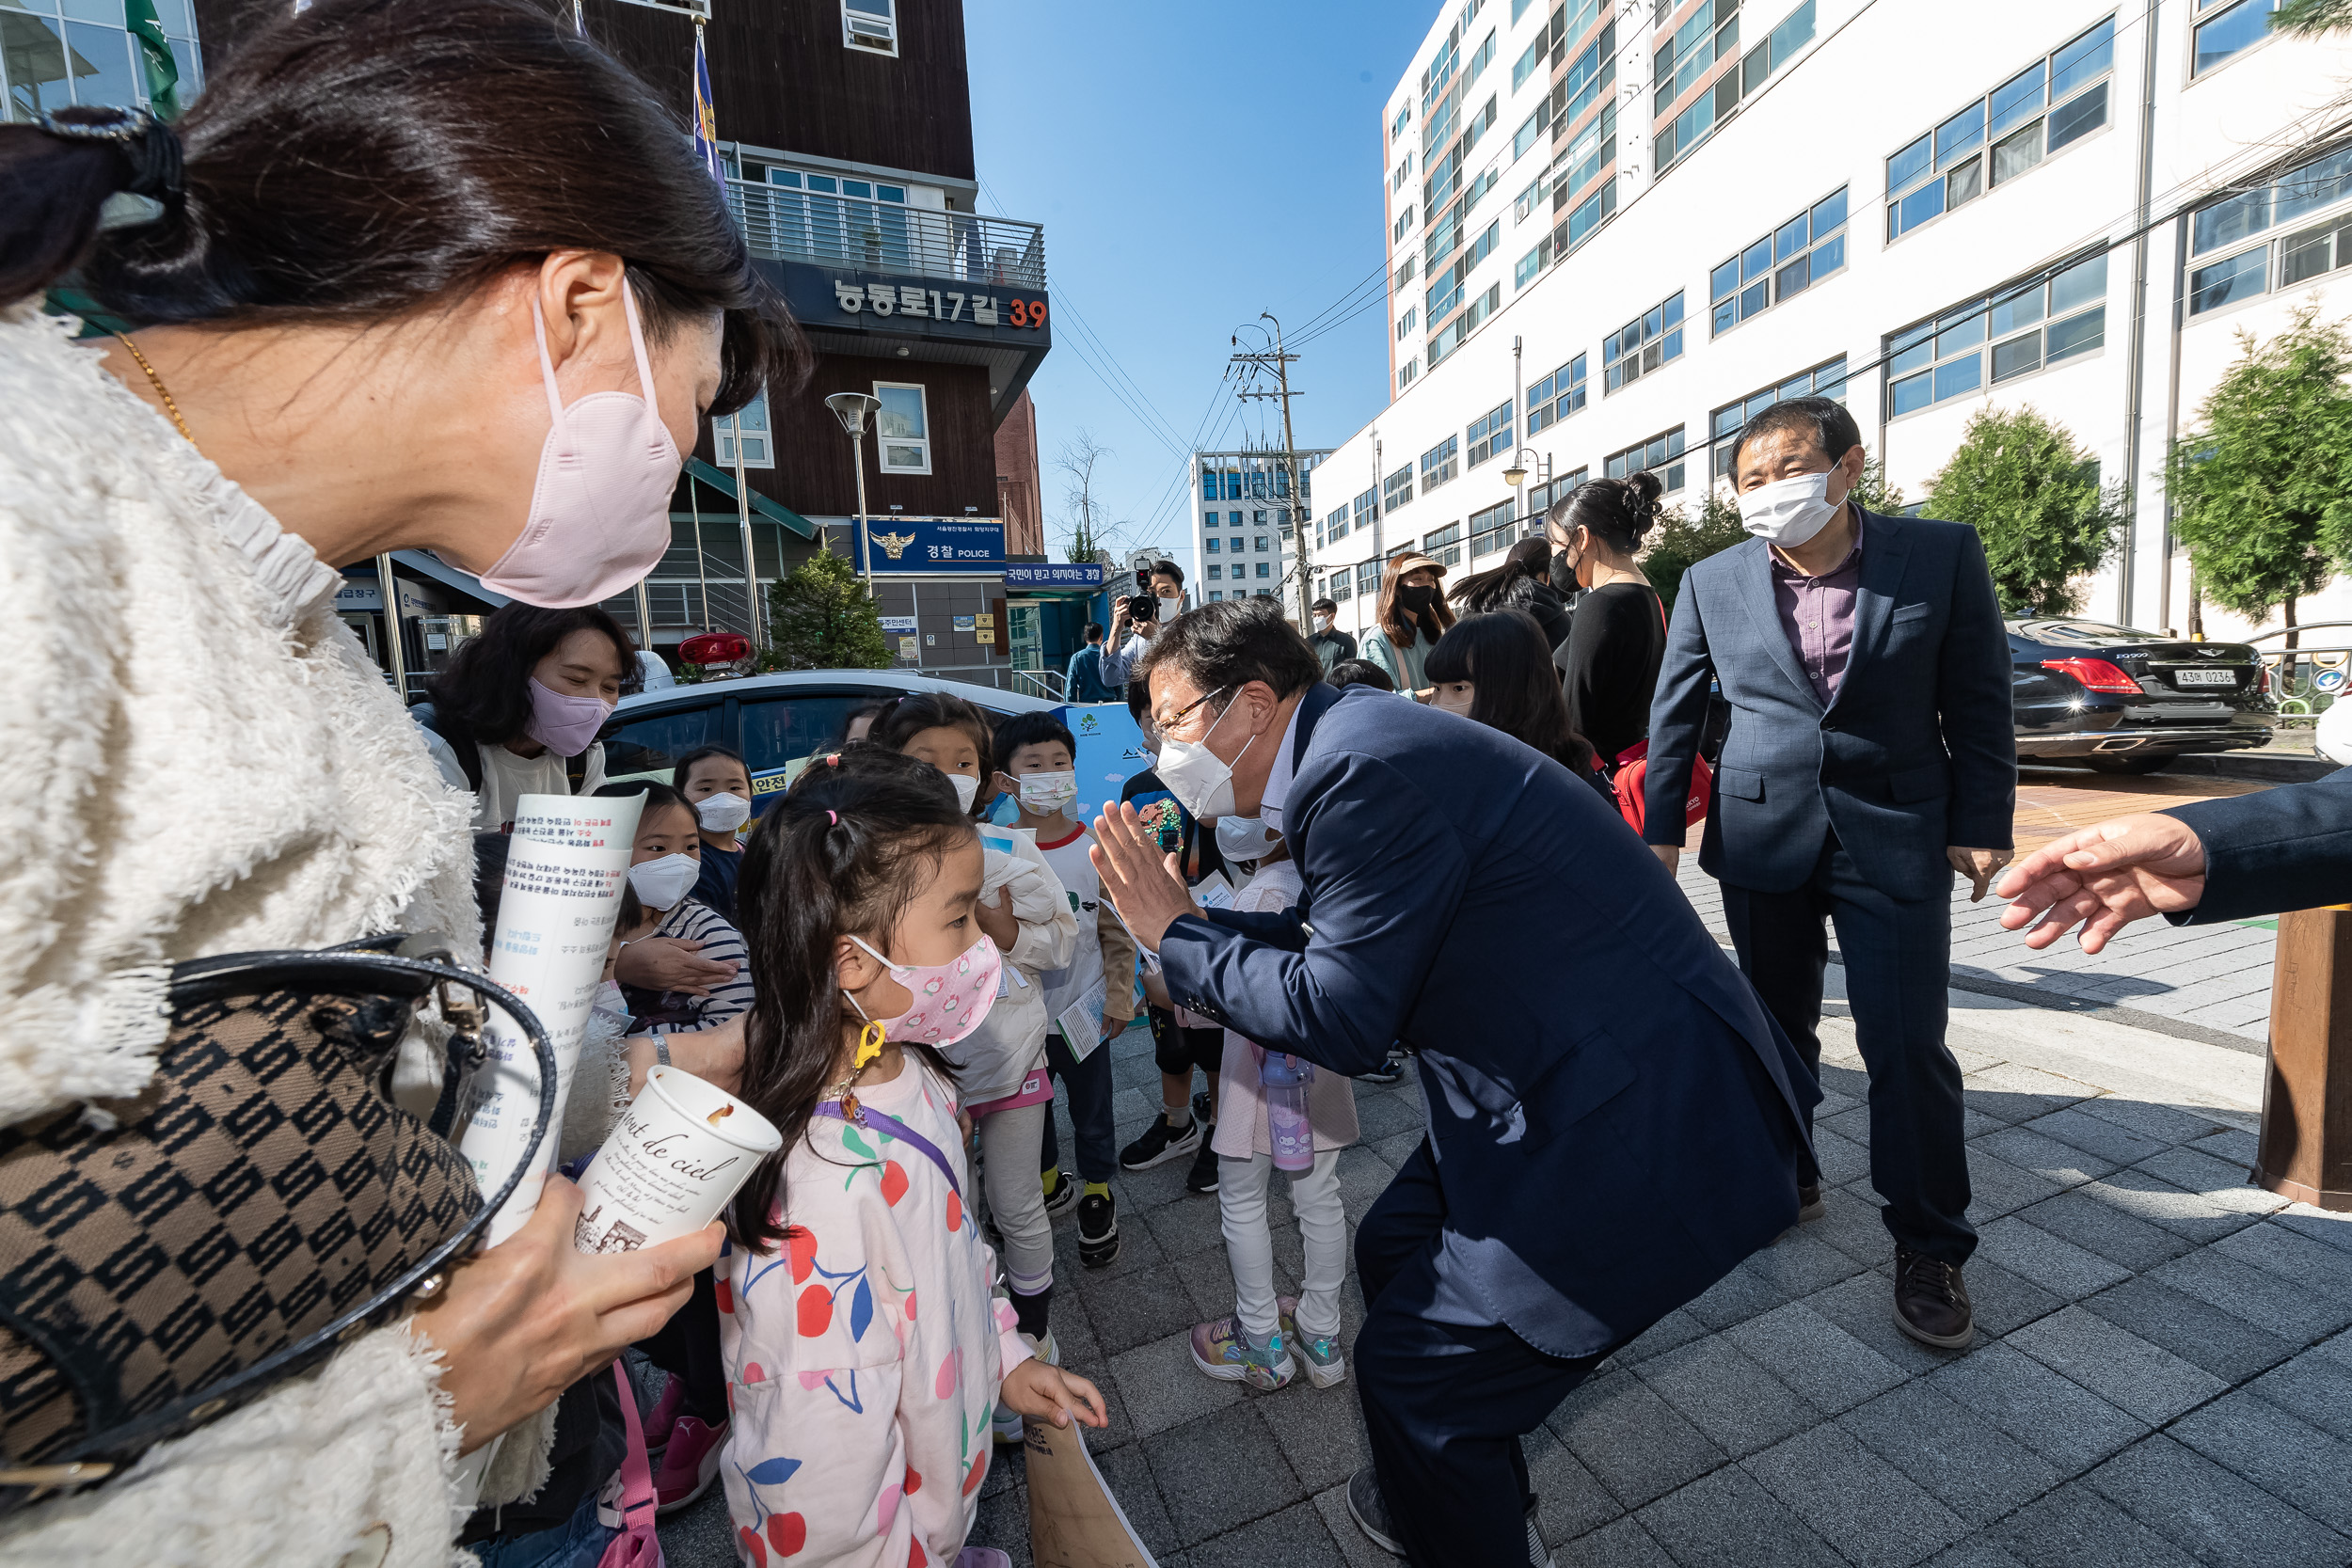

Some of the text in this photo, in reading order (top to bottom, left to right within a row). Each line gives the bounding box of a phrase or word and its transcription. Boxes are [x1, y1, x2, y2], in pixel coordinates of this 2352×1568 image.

[834, 279, 1047, 328] 능동로17길 39
[927, 545, 953, 559] 경찰
[958, 549, 990, 558] POLICE
[1008, 568, 1032, 580] 국민이
[1034, 568, 1050, 580] 믿고
[1085, 568, 1100, 580] 경찰
[2205, 672, 2232, 683] 0236
[577, 829, 592, 837] 주소
[642, 1133, 689, 1161] de
[671, 1156, 739, 1181] ciel
